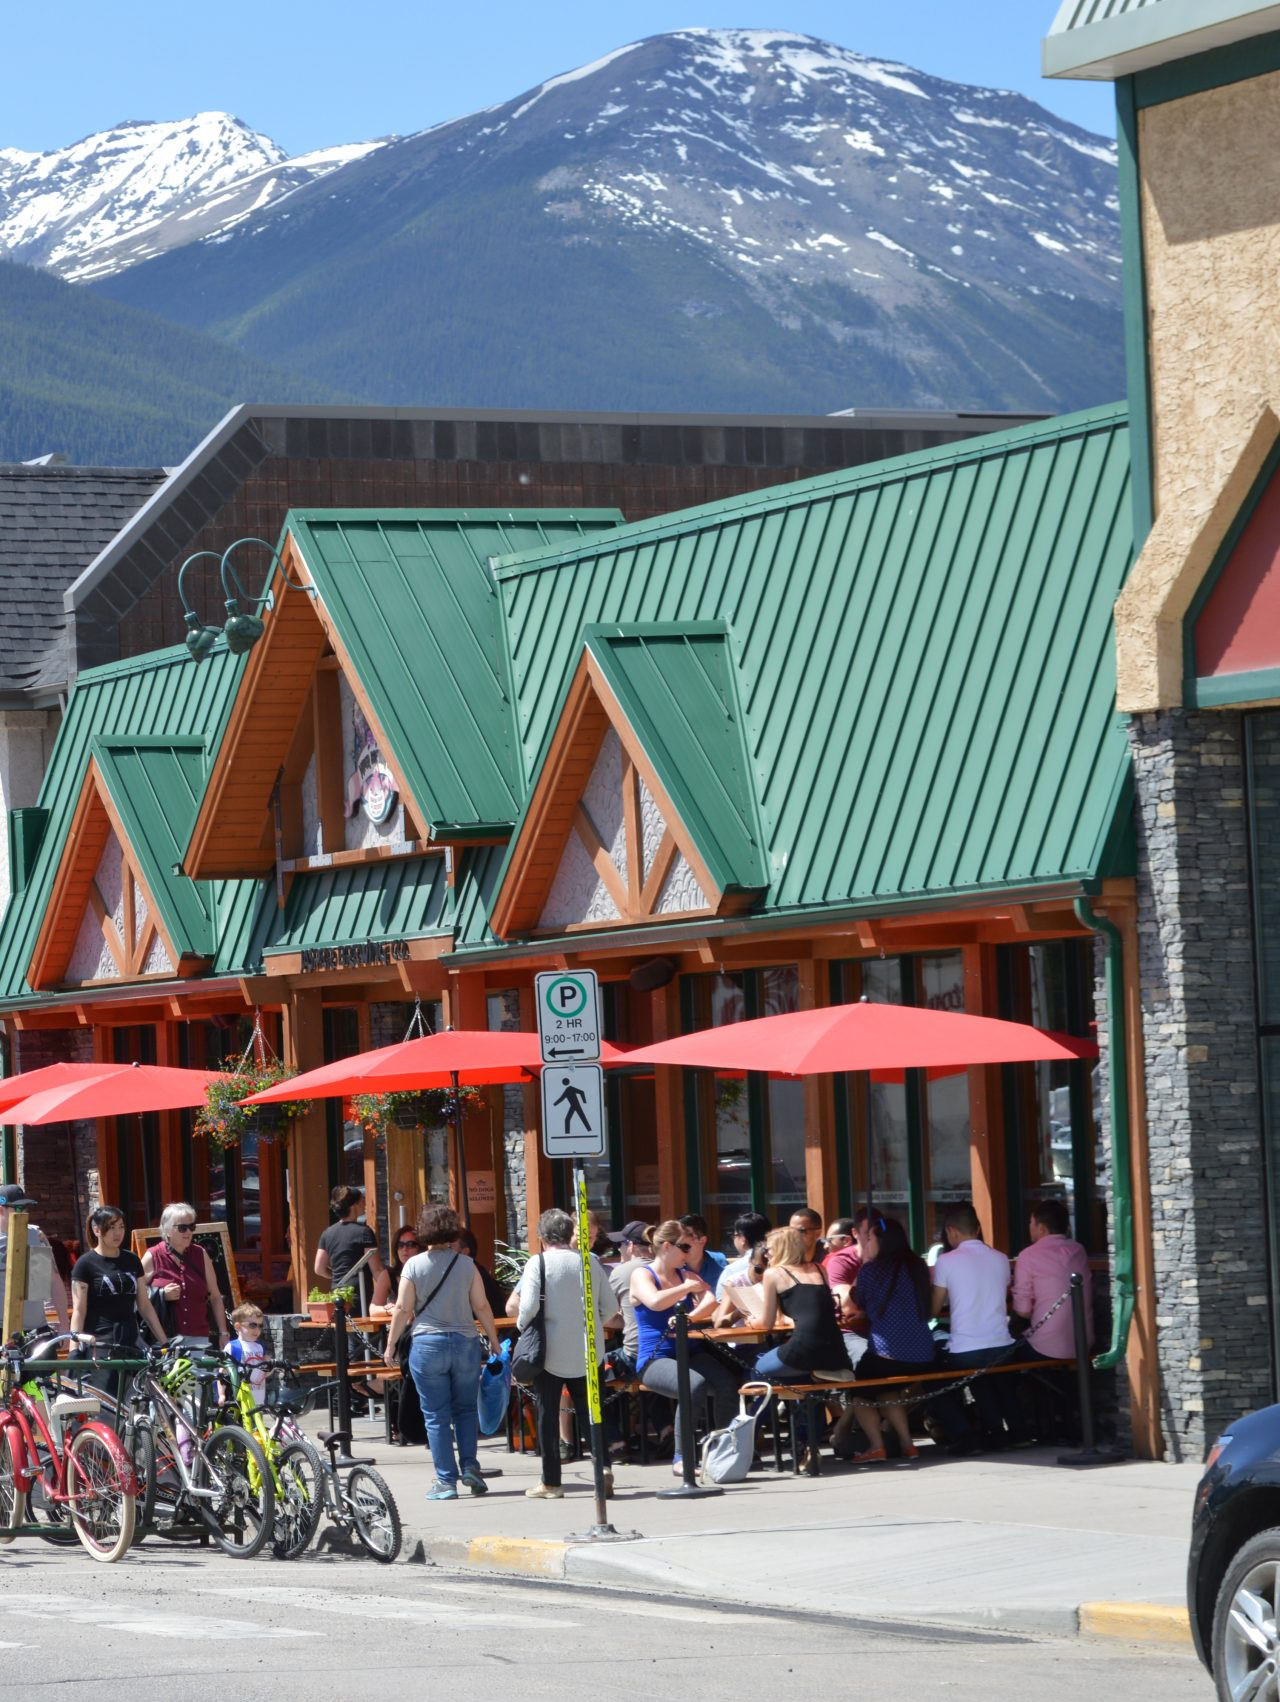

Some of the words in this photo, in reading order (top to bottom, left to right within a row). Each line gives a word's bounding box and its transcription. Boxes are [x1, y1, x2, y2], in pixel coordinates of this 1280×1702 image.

[560, 986, 577, 1008] P
[556, 1020, 563, 1029] 2
[566, 1019, 583, 1029] HR
[579, 1190, 588, 1214] NO
[581, 1228, 600, 1405] SKATEBOARDING
